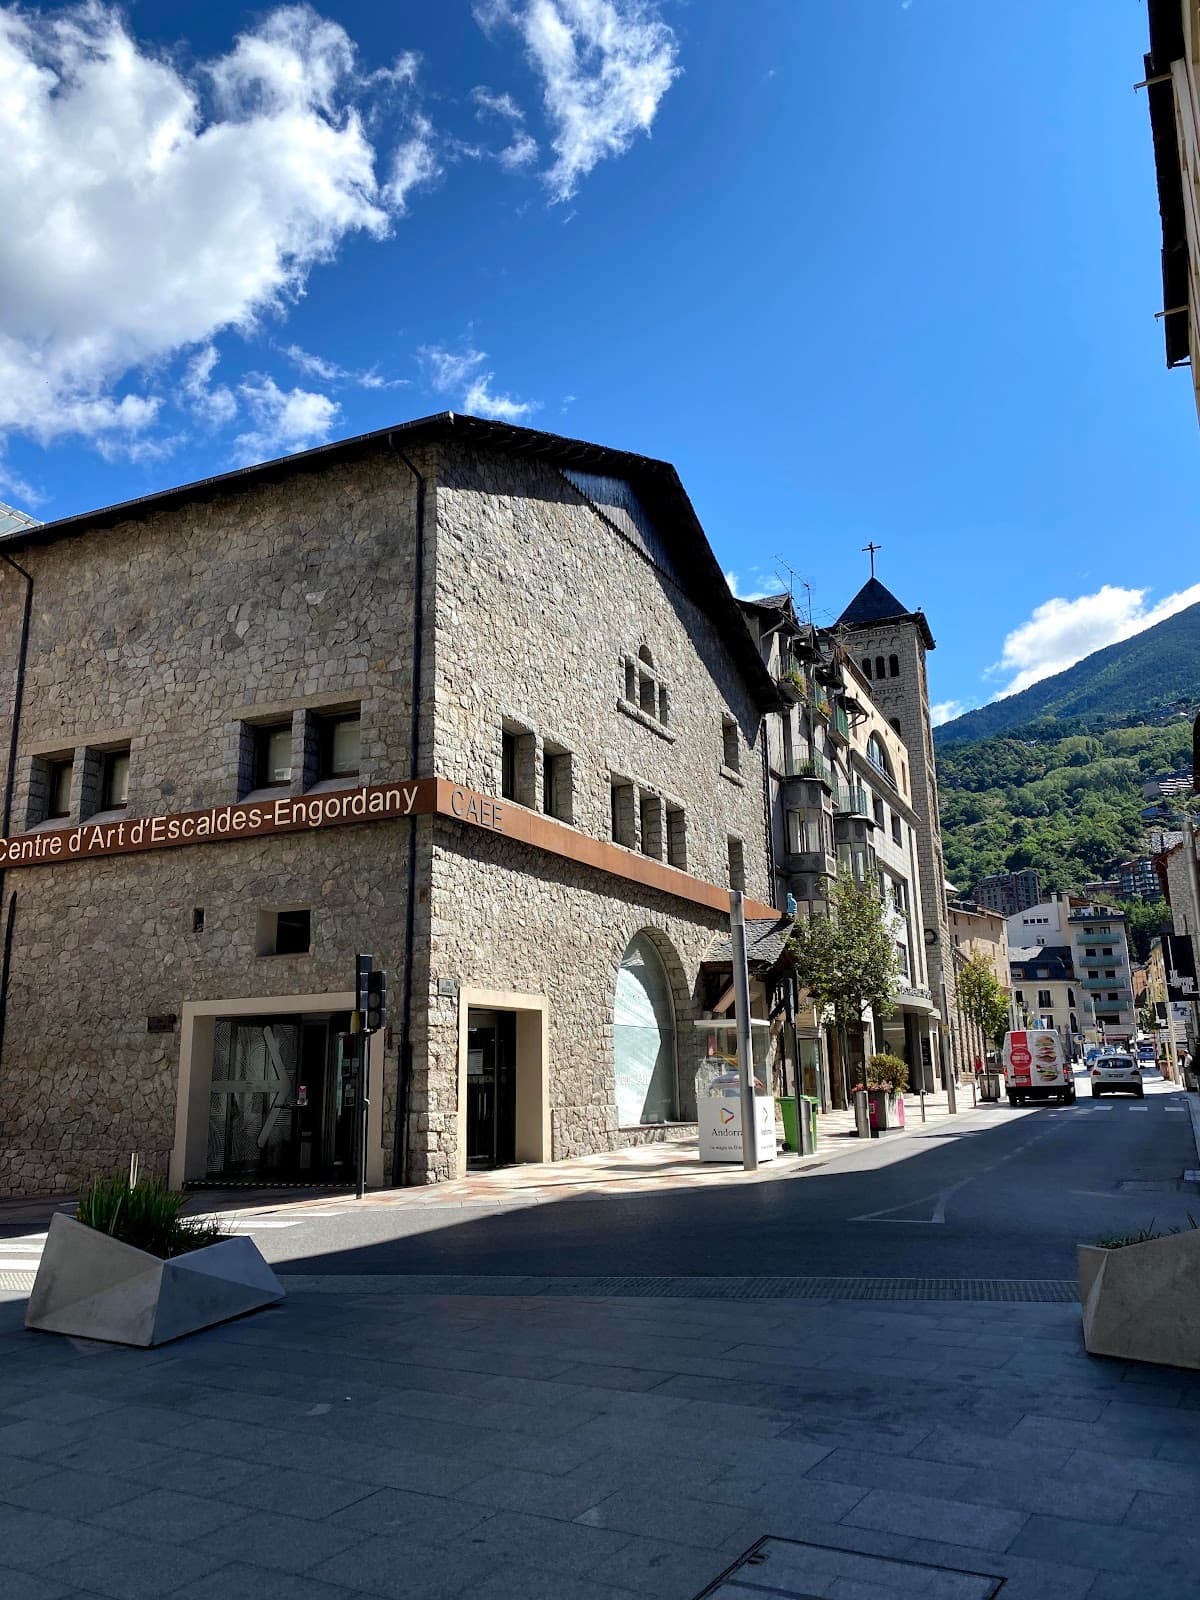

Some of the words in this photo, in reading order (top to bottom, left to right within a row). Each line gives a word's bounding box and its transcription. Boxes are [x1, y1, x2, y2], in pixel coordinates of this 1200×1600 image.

[0, 834, 62, 863] Centre
[68, 823, 125, 852] d'Art
[130, 786, 418, 844] d'Escaldes-Engordany
[451, 787, 503, 832] CAEE
